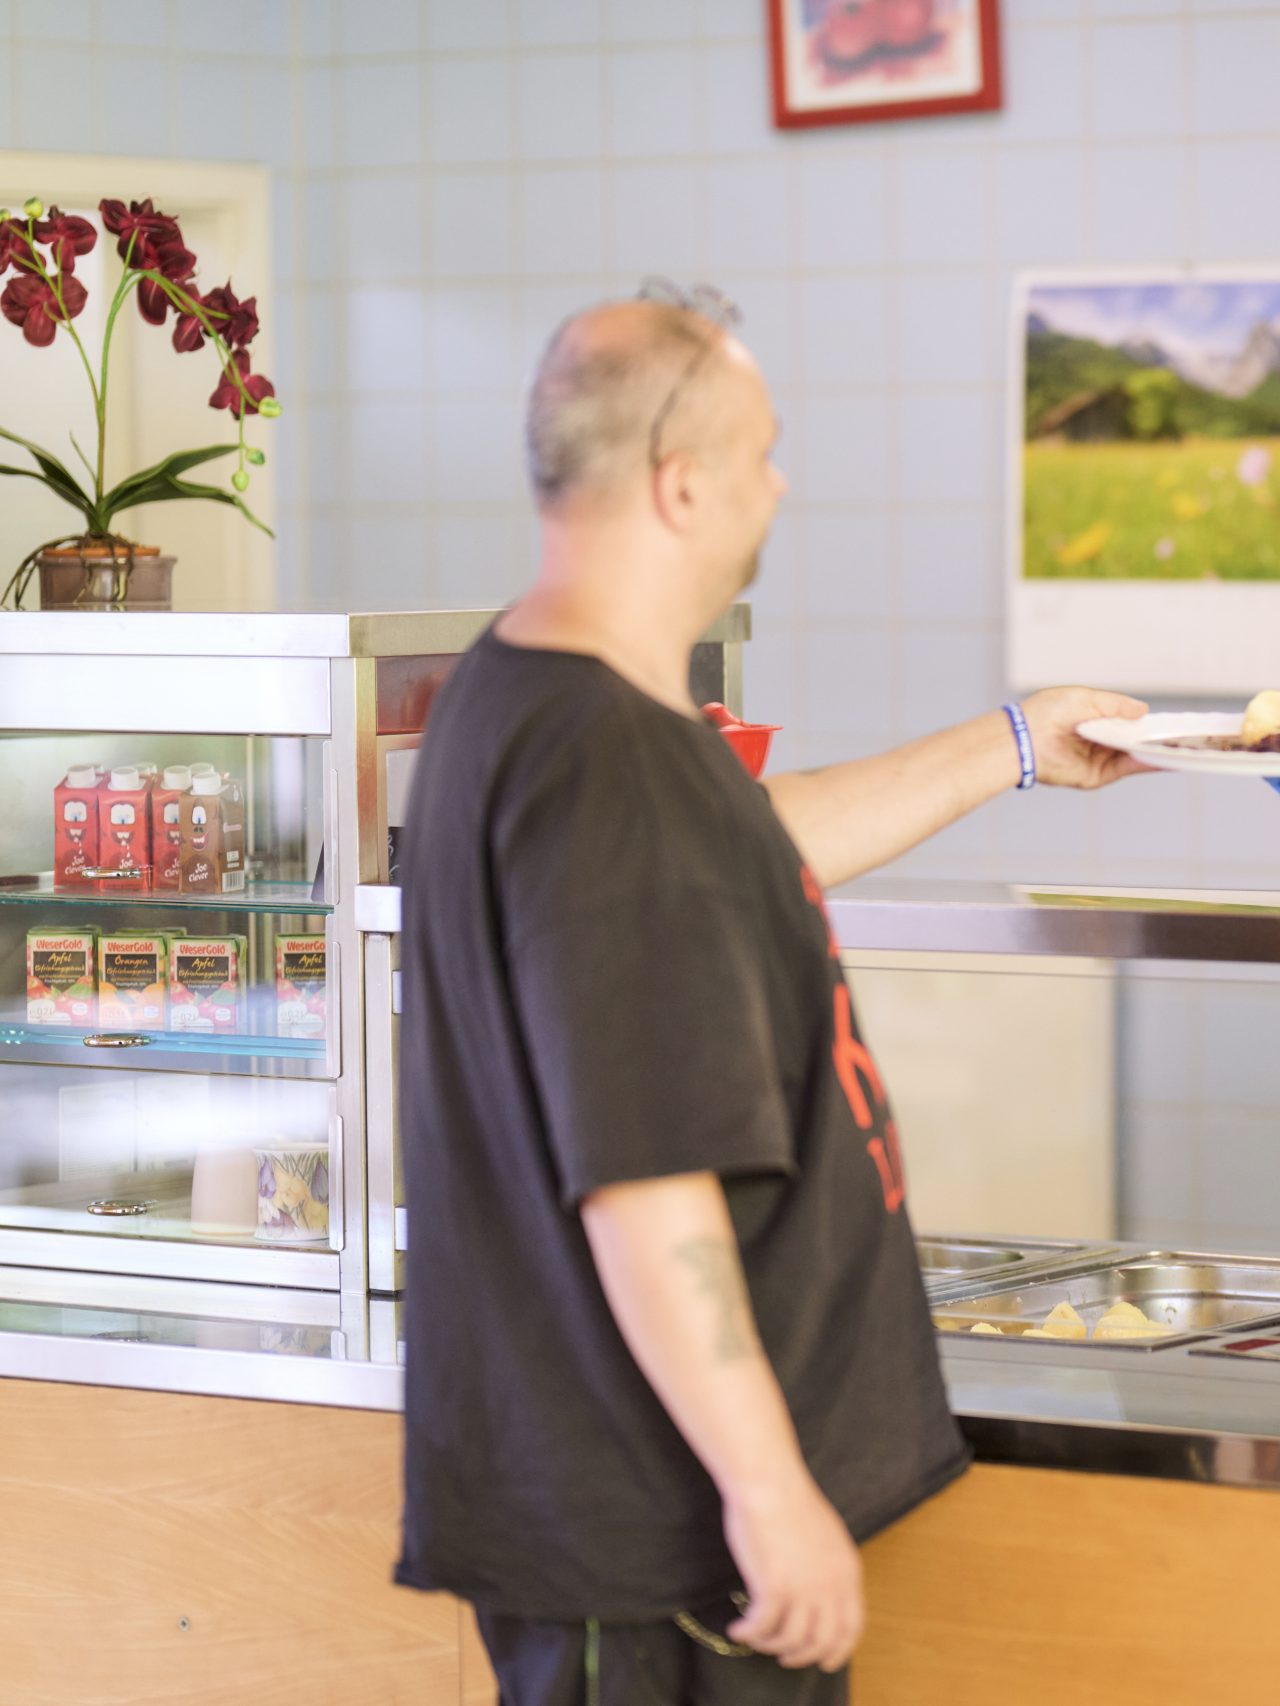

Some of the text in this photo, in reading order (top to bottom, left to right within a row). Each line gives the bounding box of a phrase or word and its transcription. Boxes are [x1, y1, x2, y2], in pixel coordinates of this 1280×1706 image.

[72, 855, 85, 866] Joe
[195, 863, 208, 874] Joe
[189, 872, 209, 882] Clever
[36, 939, 83, 950] WeserGold
[107, 942, 154, 953] WeserGold
[180, 944, 226, 955] WeserGold
[287, 940, 326, 951] WeserGo
[48, 952, 72, 966] Apfel
[115, 955, 149, 968] Orangen
[191, 957, 216, 971] Apfel
[298, 953, 323, 967] Apfel
